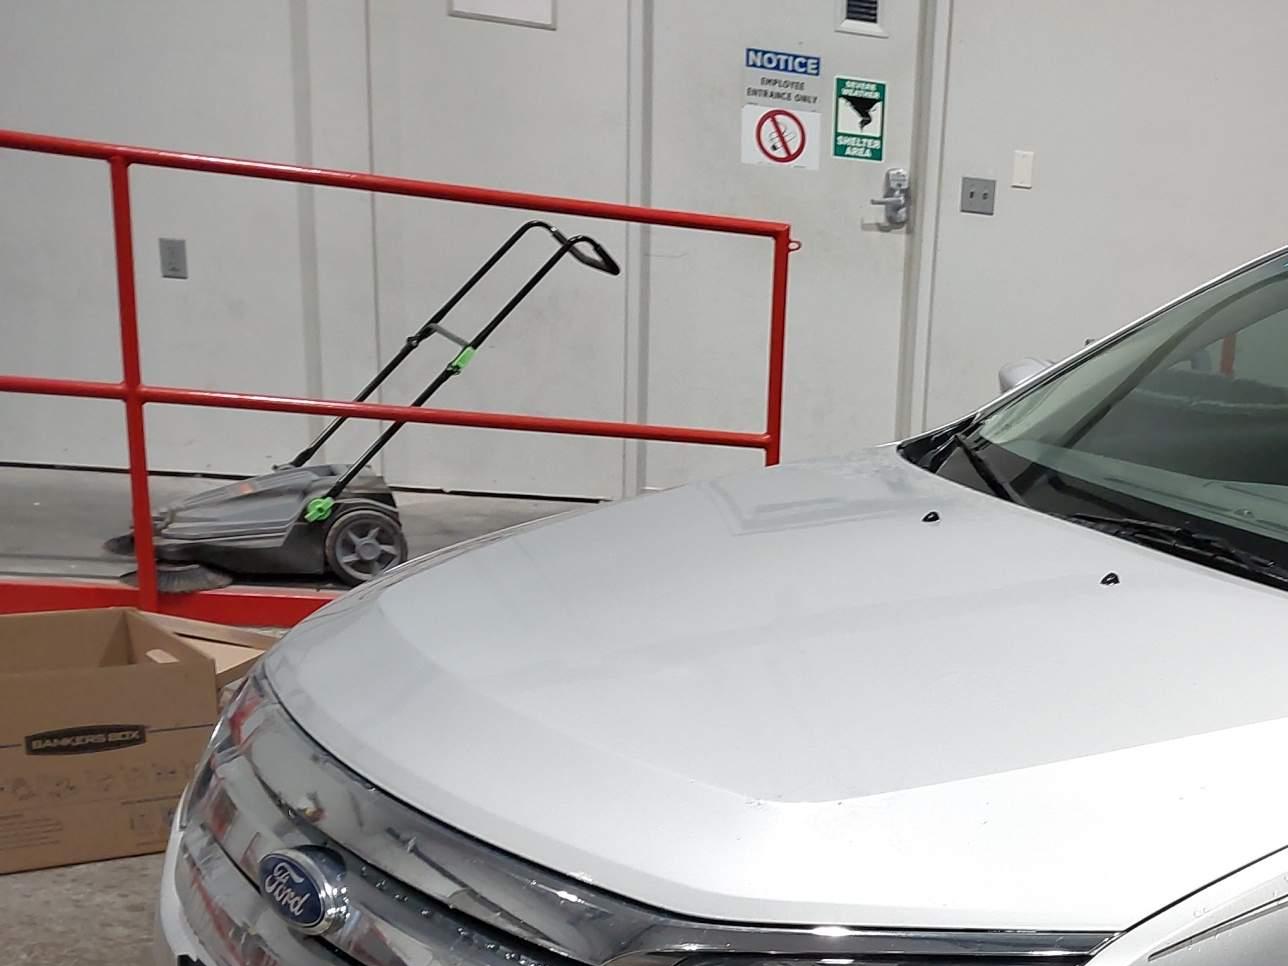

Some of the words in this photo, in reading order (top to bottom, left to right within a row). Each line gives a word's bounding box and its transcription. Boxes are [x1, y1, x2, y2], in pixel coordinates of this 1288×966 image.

[749, 51, 818, 74] NOTICE
[760, 77, 805, 91] EMPLOYEE
[746, 87, 792, 101] ENTRANCE
[794, 93, 818, 104] ONLY
[836, 136, 880, 149] SHELTER
[844, 147, 872, 158] AREA
[31, 733, 106, 750] BANKERS
[108, 730, 140, 743] BOX
[264, 862, 311, 916] Ford
